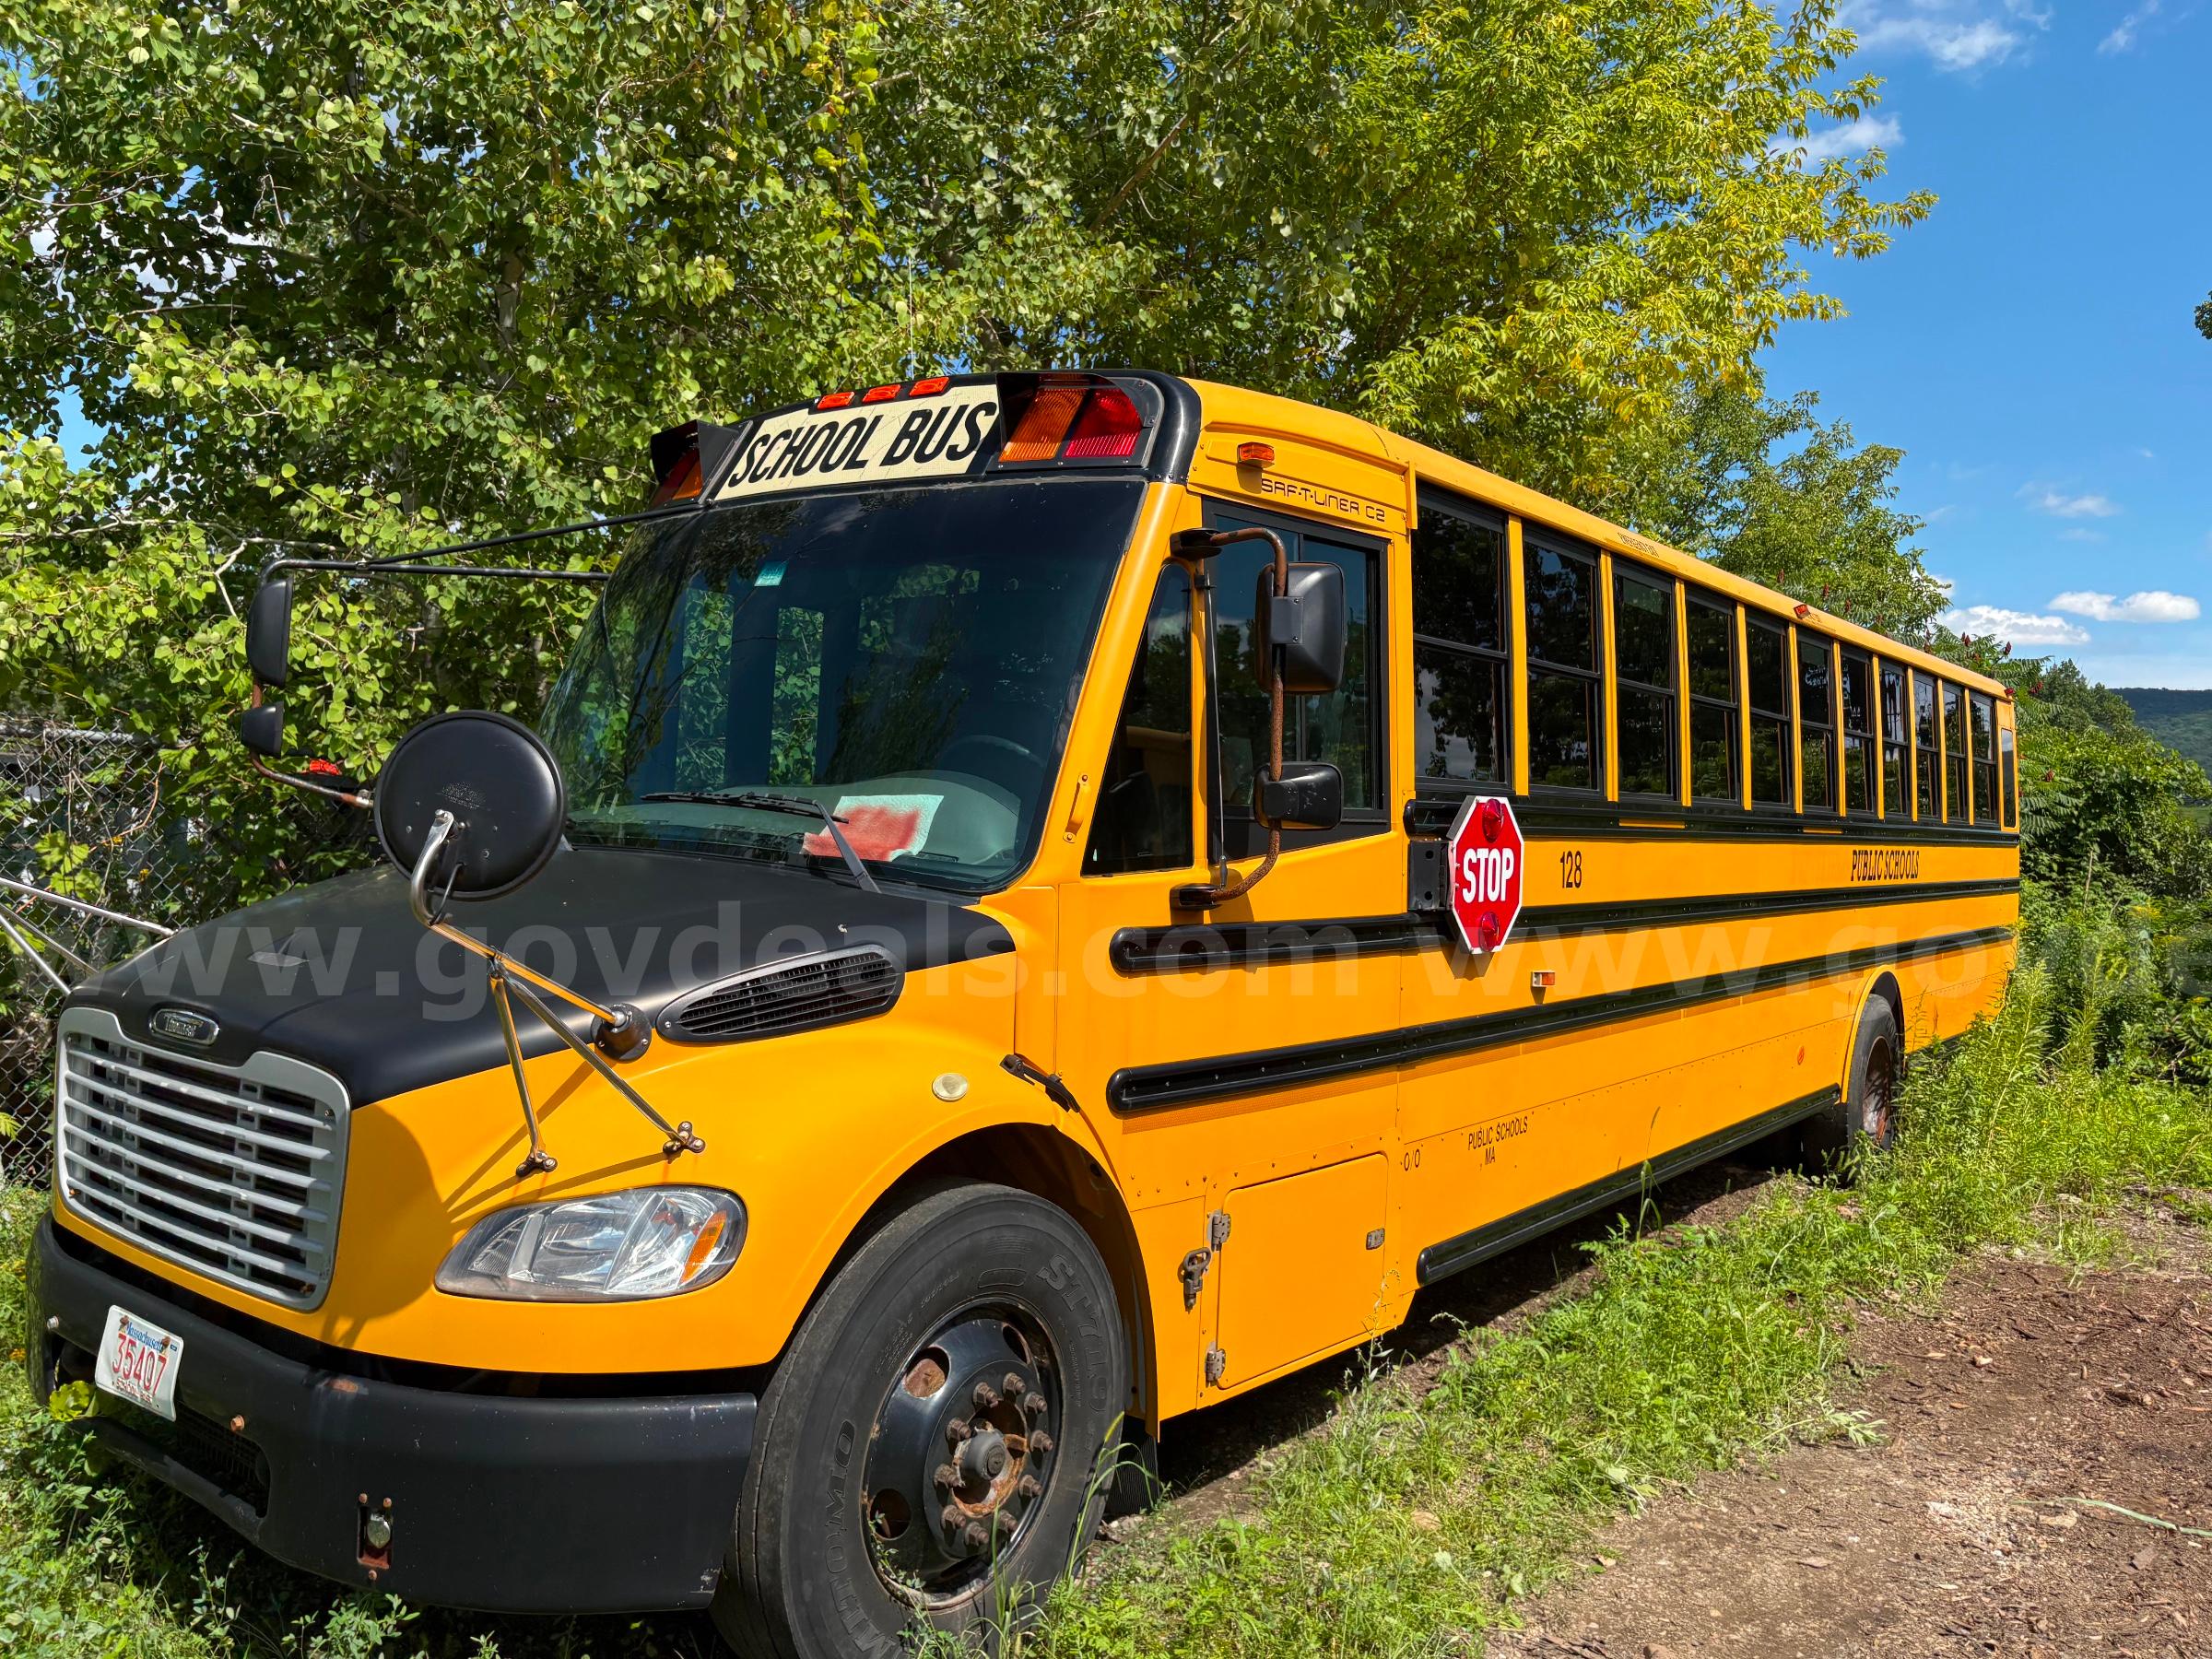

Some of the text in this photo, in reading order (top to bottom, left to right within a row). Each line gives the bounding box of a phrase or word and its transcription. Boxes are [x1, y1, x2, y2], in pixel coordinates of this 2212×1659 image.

[728, 401, 997, 488] SCHOOL BUS
[1365, 505, 1385, 523] C2
[1462, 847, 1514, 903] STOP
[1559, 851, 1583, 888] 128
[1851, 849, 1920, 882] PUBLIC SCHOOLS
[1468, 1115, 1528, 1150] PUBLIC SCHOOLS
[1485, 1146, 1496, 1165] MA
[125, 1322, 164, 1354] Massachusett
[112, 1333, 169, 1397] 35407
